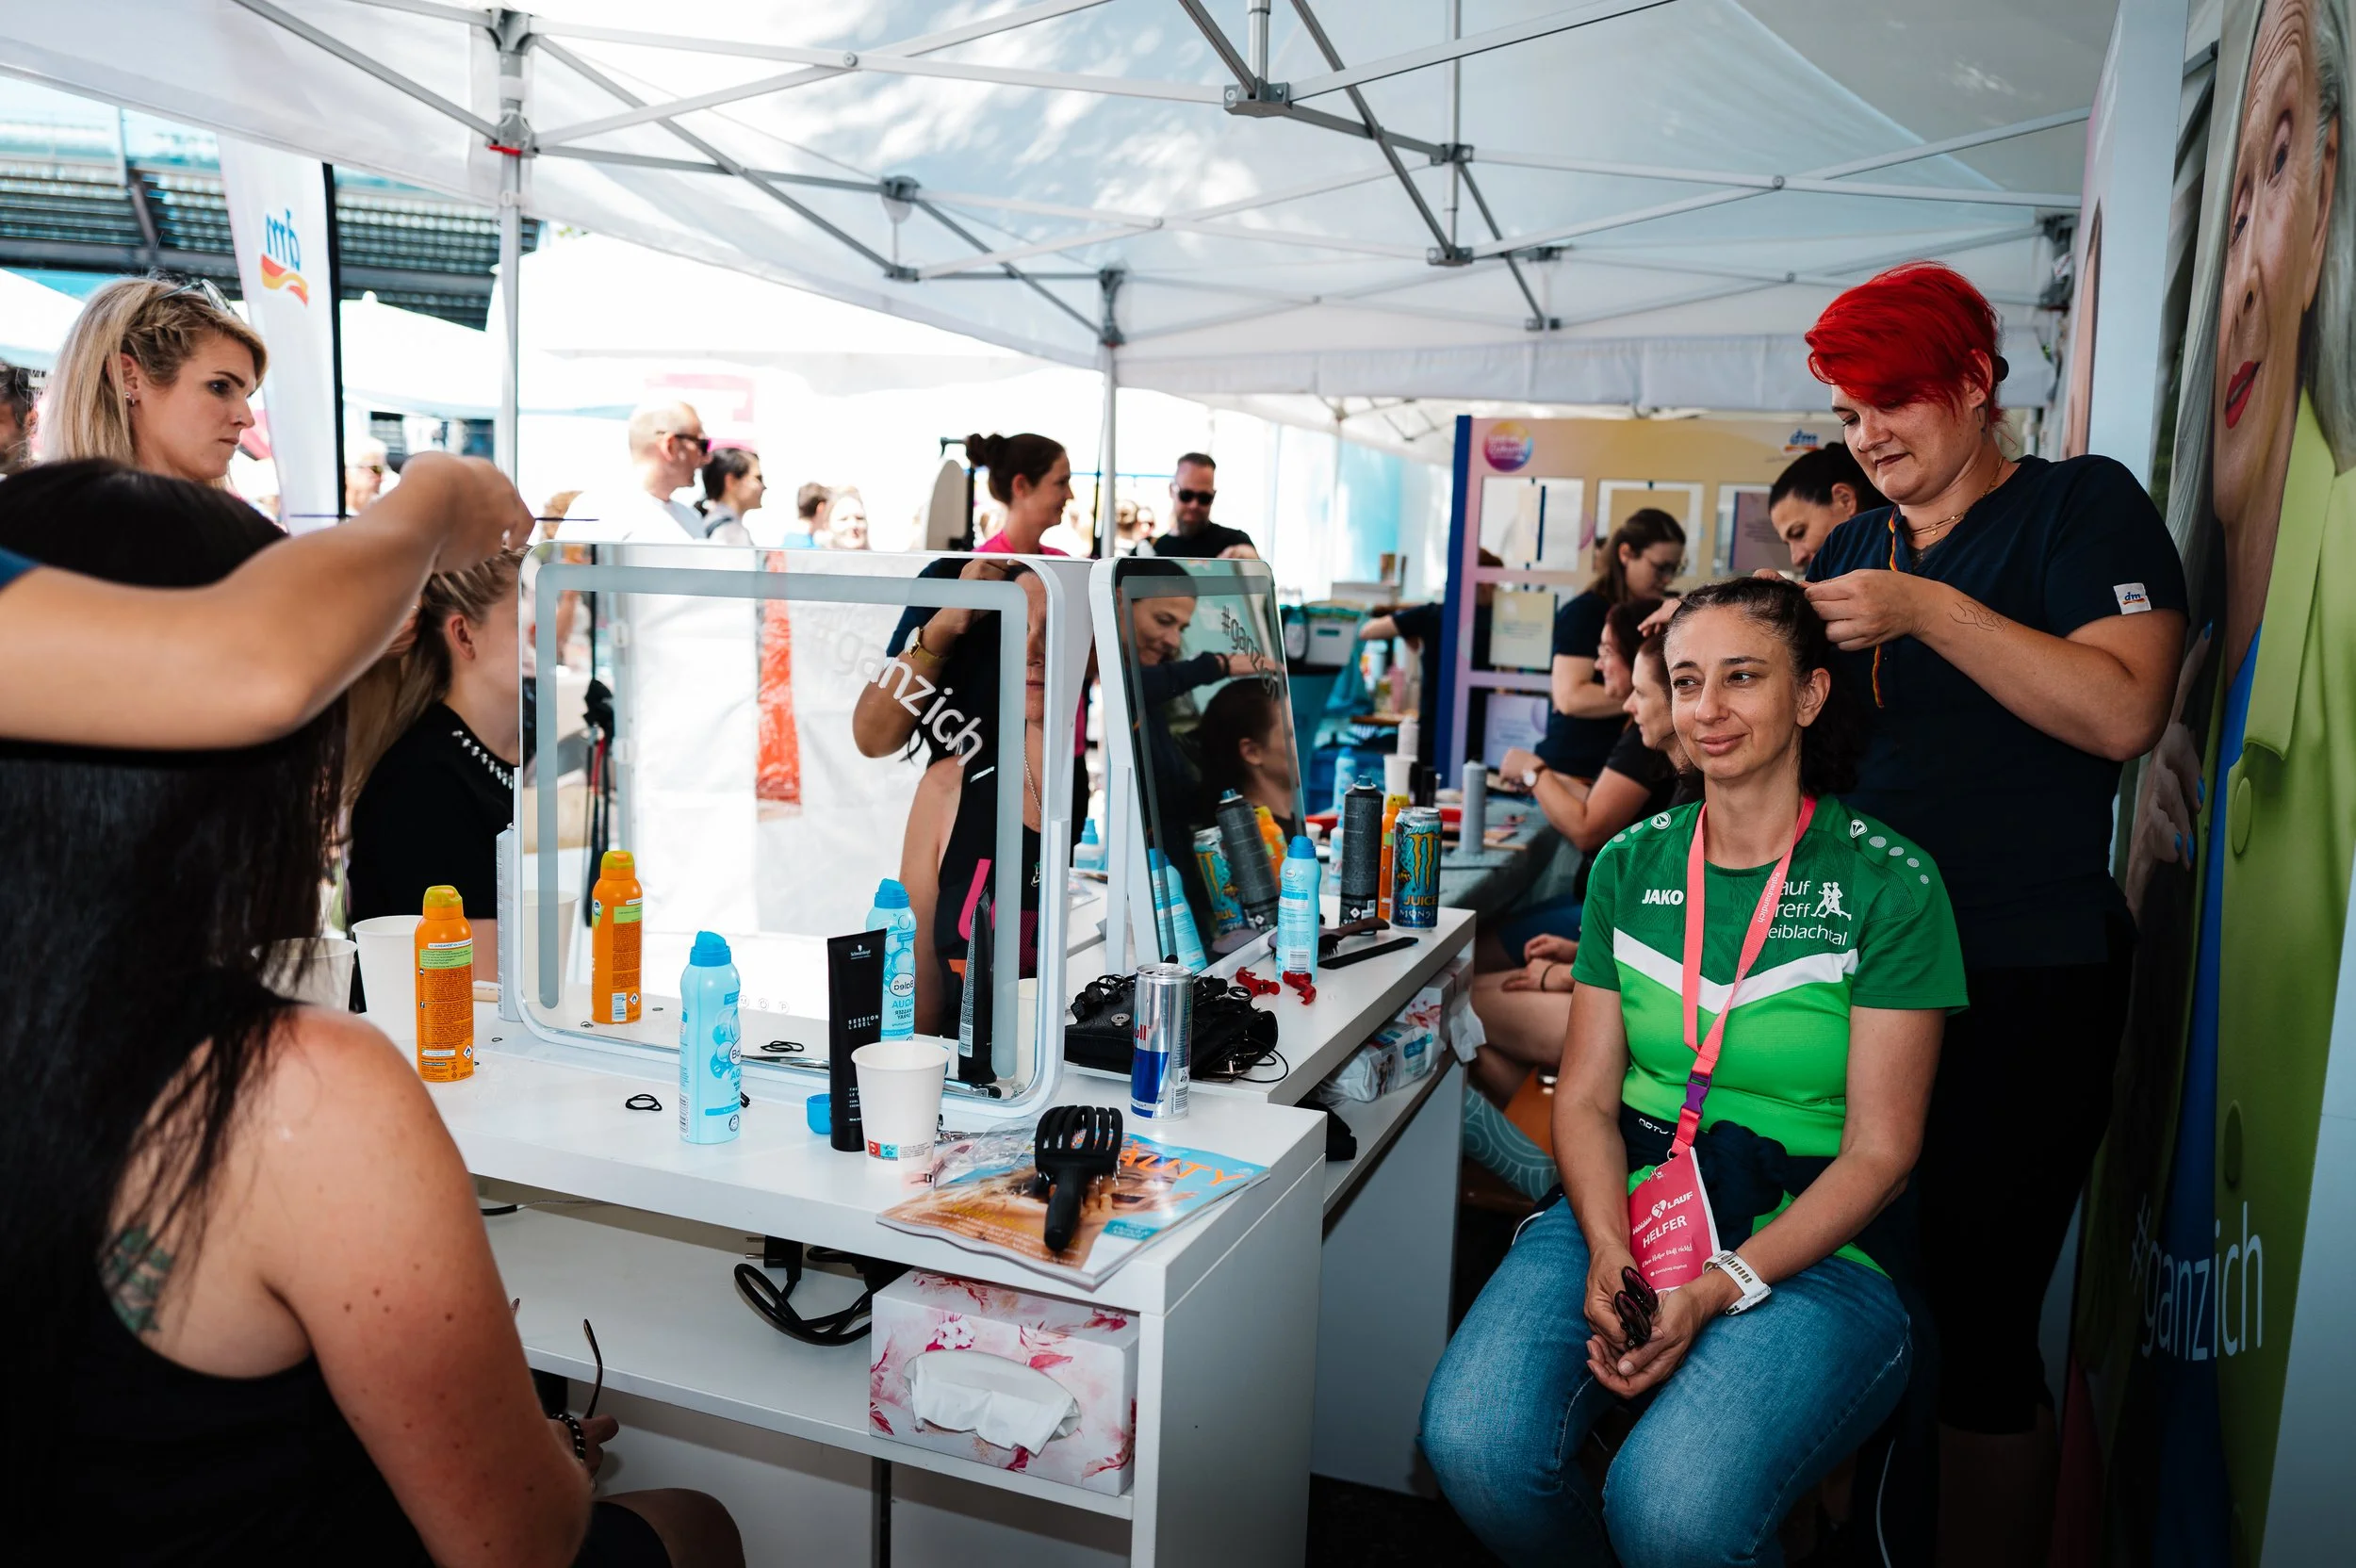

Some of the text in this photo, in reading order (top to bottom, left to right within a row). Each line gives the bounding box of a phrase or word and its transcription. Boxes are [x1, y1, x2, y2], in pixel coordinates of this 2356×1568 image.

[1790, 429, 1817, 446] dm
[2124, 591, 2141, 601] dm
[1779, 880, 1811, 896] auf
[1641, 889, 1685, 906] JAKO
[1757, 872, 1781, 923] #glaubandich
[1774, 903, 1811, 918] reff
[1766, 924, 1847, 946] eiblachtal
[848, 1015, 879, 1025] SESSION
[1134, 1023, 1147, 1040] ull
[1121, 1149, 1245, 1187] AUTY
[1666, 1191, 1693, 1210] LAUF
[1643, 1215, 1688, 1249] HELFER
[2129, 1193, 2264, 1362] #ganzich
